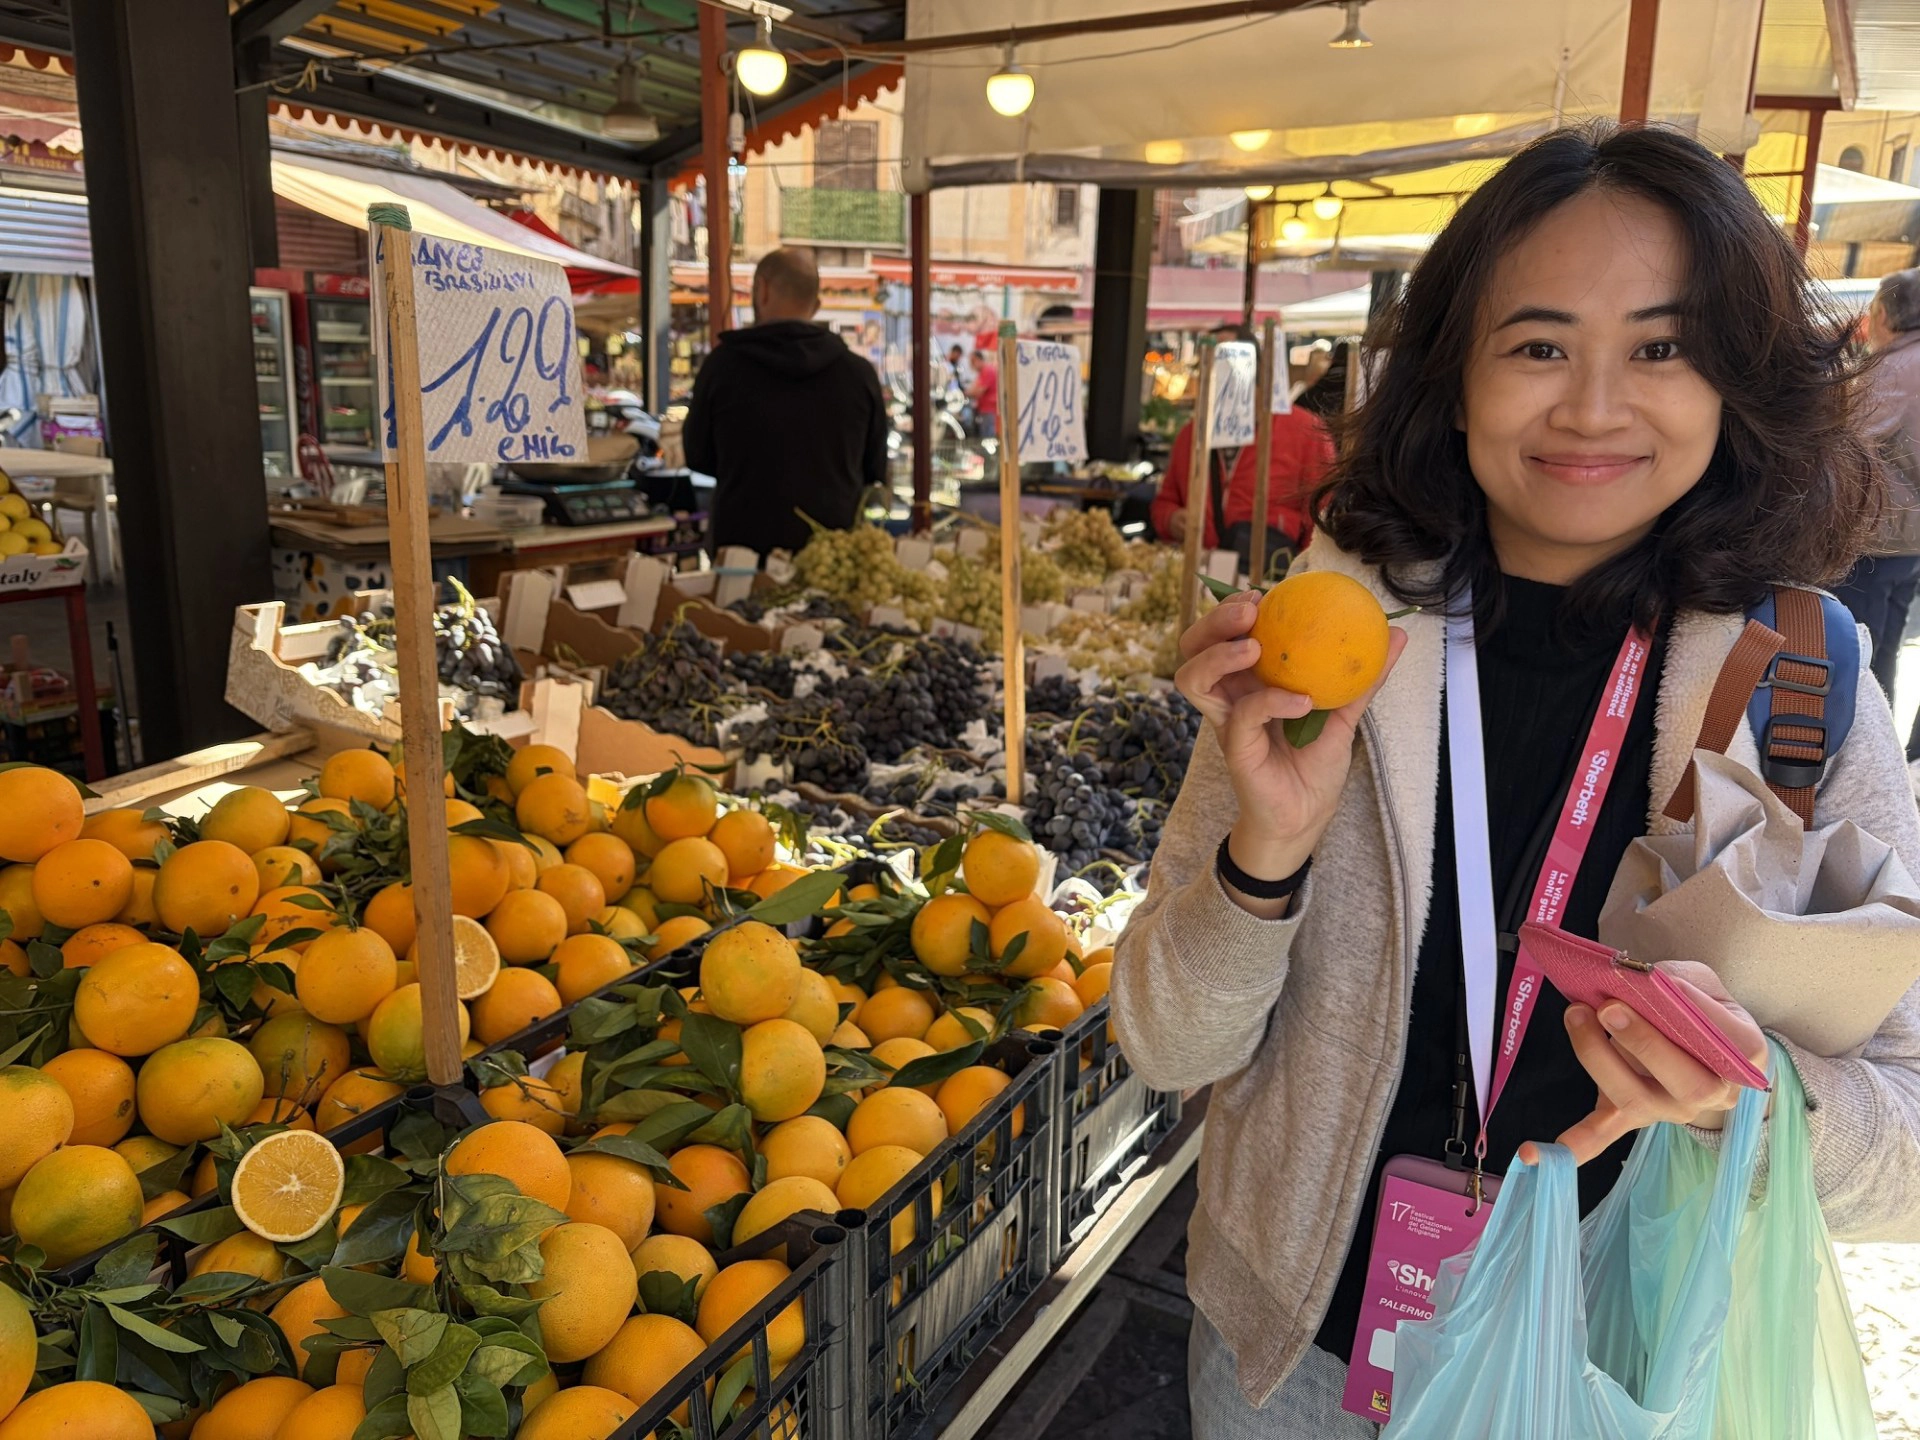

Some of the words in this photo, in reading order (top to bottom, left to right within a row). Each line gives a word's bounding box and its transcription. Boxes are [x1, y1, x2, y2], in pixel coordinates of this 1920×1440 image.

[1621, 641, 1637, 672] gelato
[1629, 662, 1638, 675] an
[1606, 672, 1626, 718] addicted.
[1617, 676, 1635, 718] artisanal
[1570, 754, 1608, 826] Sherbeth
[1544, 870, 1559, 897] molti
[1557, 872, 1569, 885] La
[1550, 887, 1563, 906] vita
[1545, 907, 1558, 921] ha
[1503, 981, 1533, 1056] Sherbeth
[1409, 1215, 1453, 1232] Internazionale
[1410, 1209, 1435, 1221] Festival
[1407, 1226, 1440, 1240] Artigianale
[1408, 1220, 1419, 1228] del
[1419, 1223, 1440, 1234] Gelato
[1395, 1284, 1429, 1300] L'innova
[1379, 1297, 1433, 1320] PALERMO
